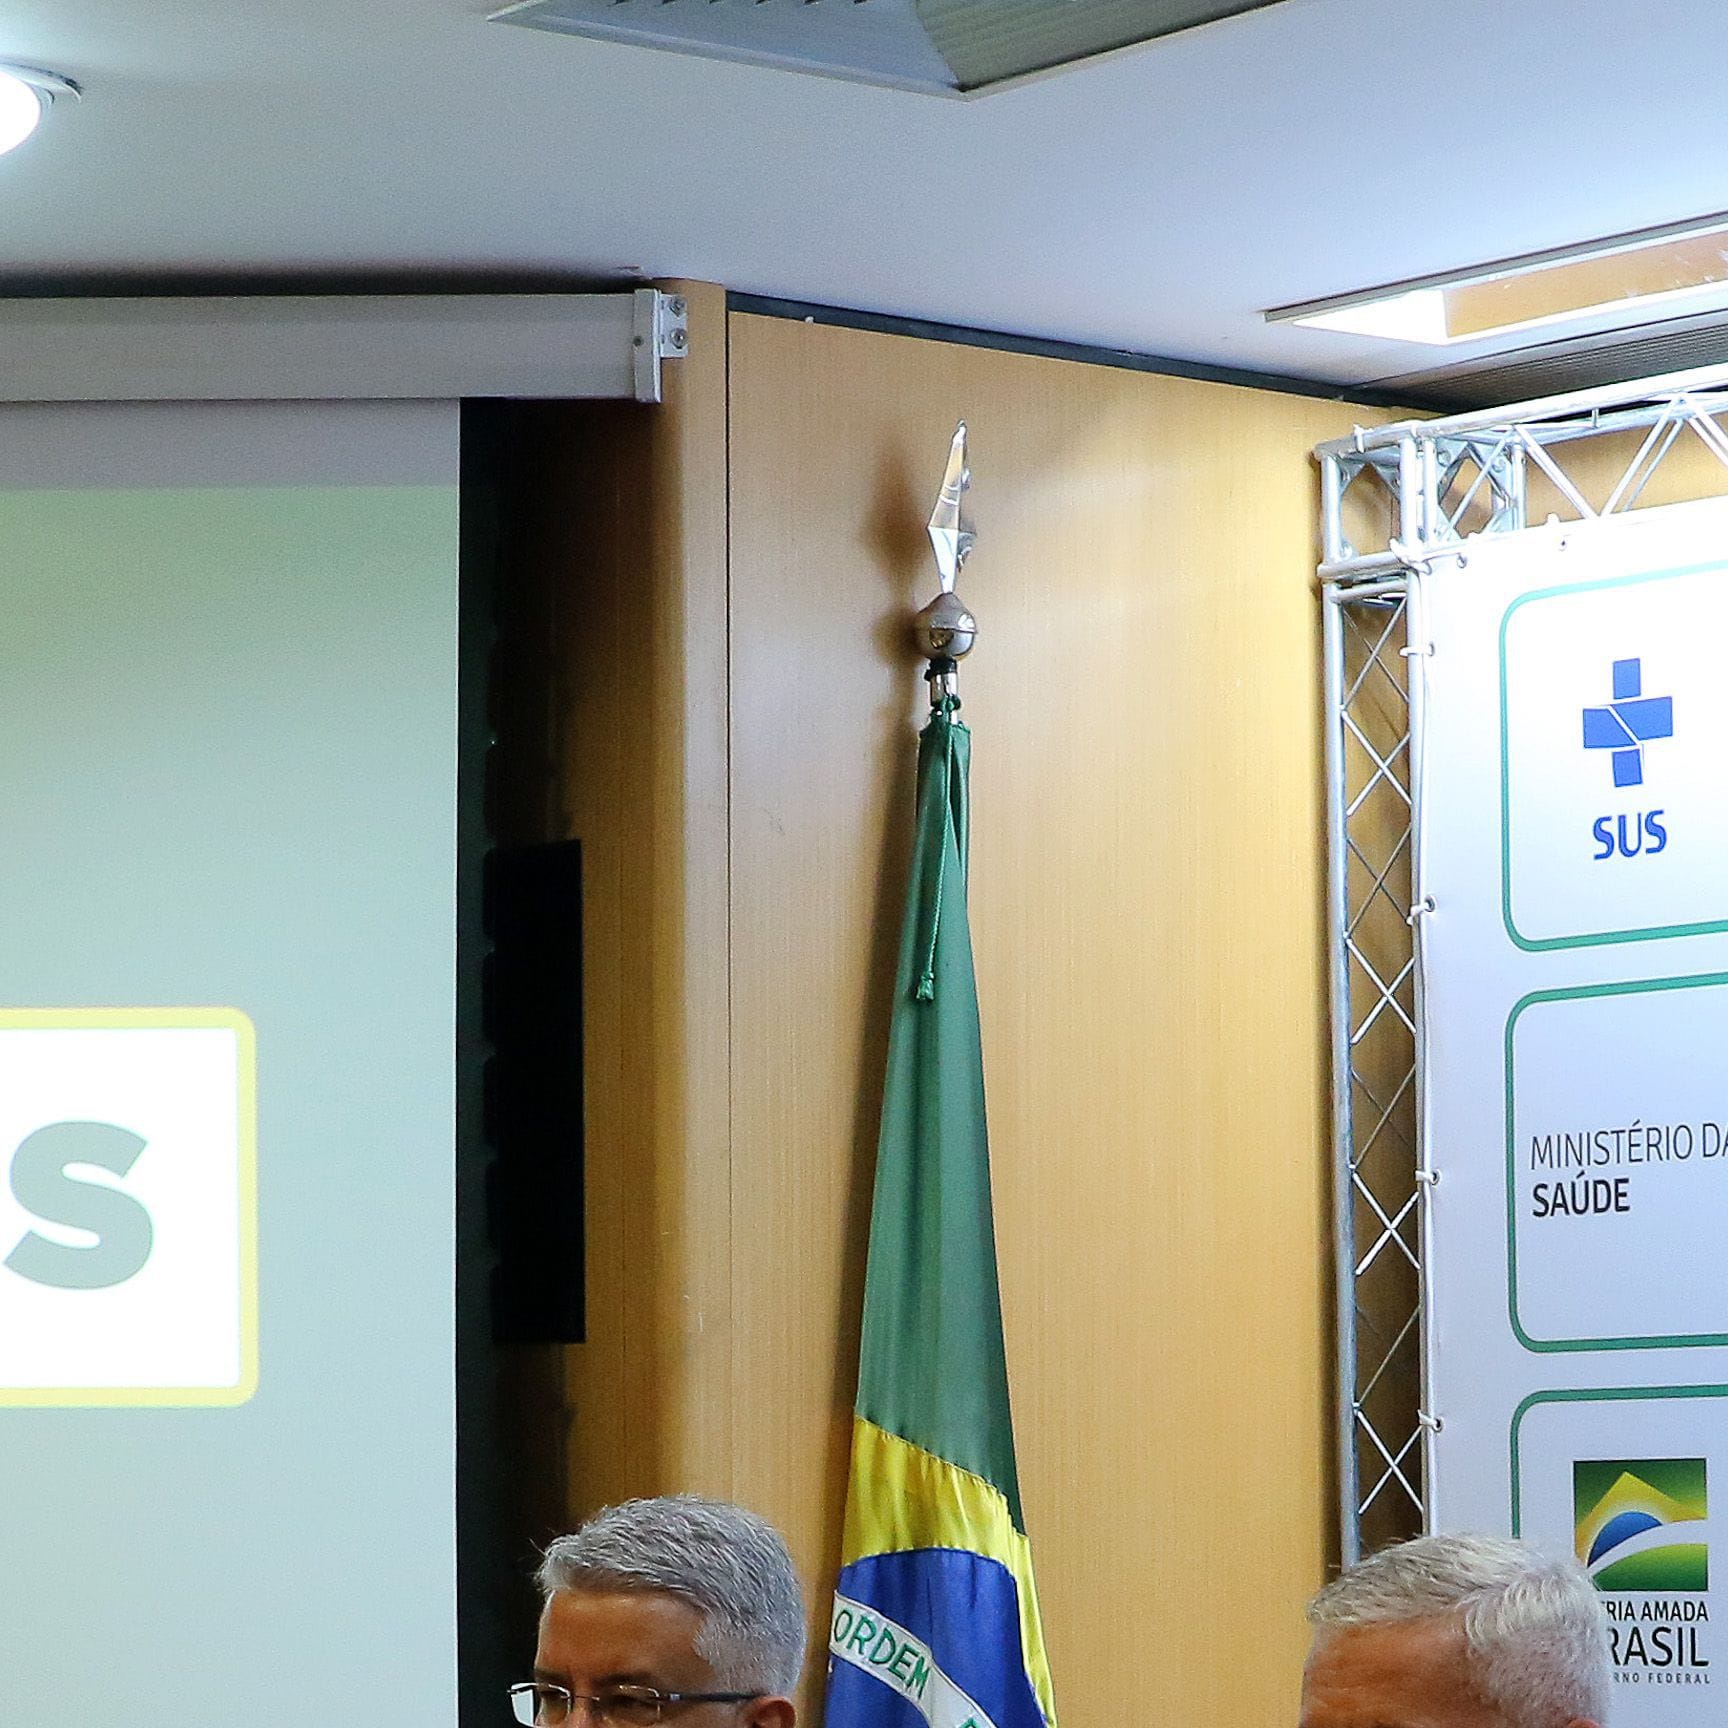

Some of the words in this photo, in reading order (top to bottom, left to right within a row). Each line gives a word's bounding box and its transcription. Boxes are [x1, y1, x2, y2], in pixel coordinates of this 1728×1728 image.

[1592, 809, 1668, 861] SUS
[1530, 1118, 1693, 1171] MINISTÉRIO
[1532, 1169, 1631, 1218] SAÚDE
[1605, 1600, 1636, 1621] RIA
[1640, 1600, 1709, 1621] AMADA
[833, 1608, 932, 1700] ORDEM
[1607, 1626, 1710, 1667] RASIL
[1647, 1672, 1711, 1684] FEDERAL
